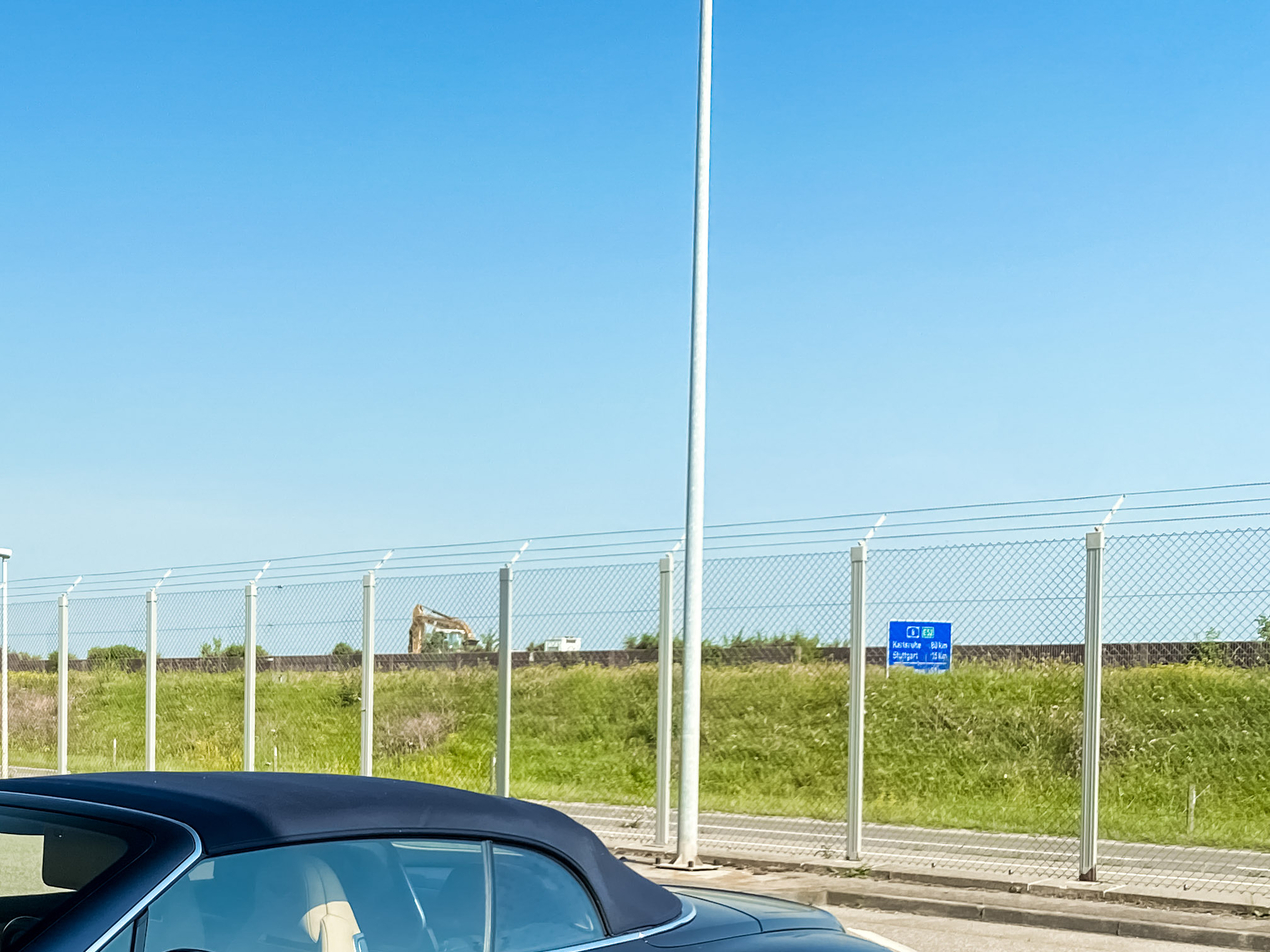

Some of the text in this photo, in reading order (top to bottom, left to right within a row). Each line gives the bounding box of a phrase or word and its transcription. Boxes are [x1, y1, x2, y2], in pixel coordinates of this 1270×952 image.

[892, 640, 922, 649] Karlsruhe
[938, 641, 948, 649] km
[892, 651, 919, 661] Stuttgart
[938, 652, 948, 660] km
